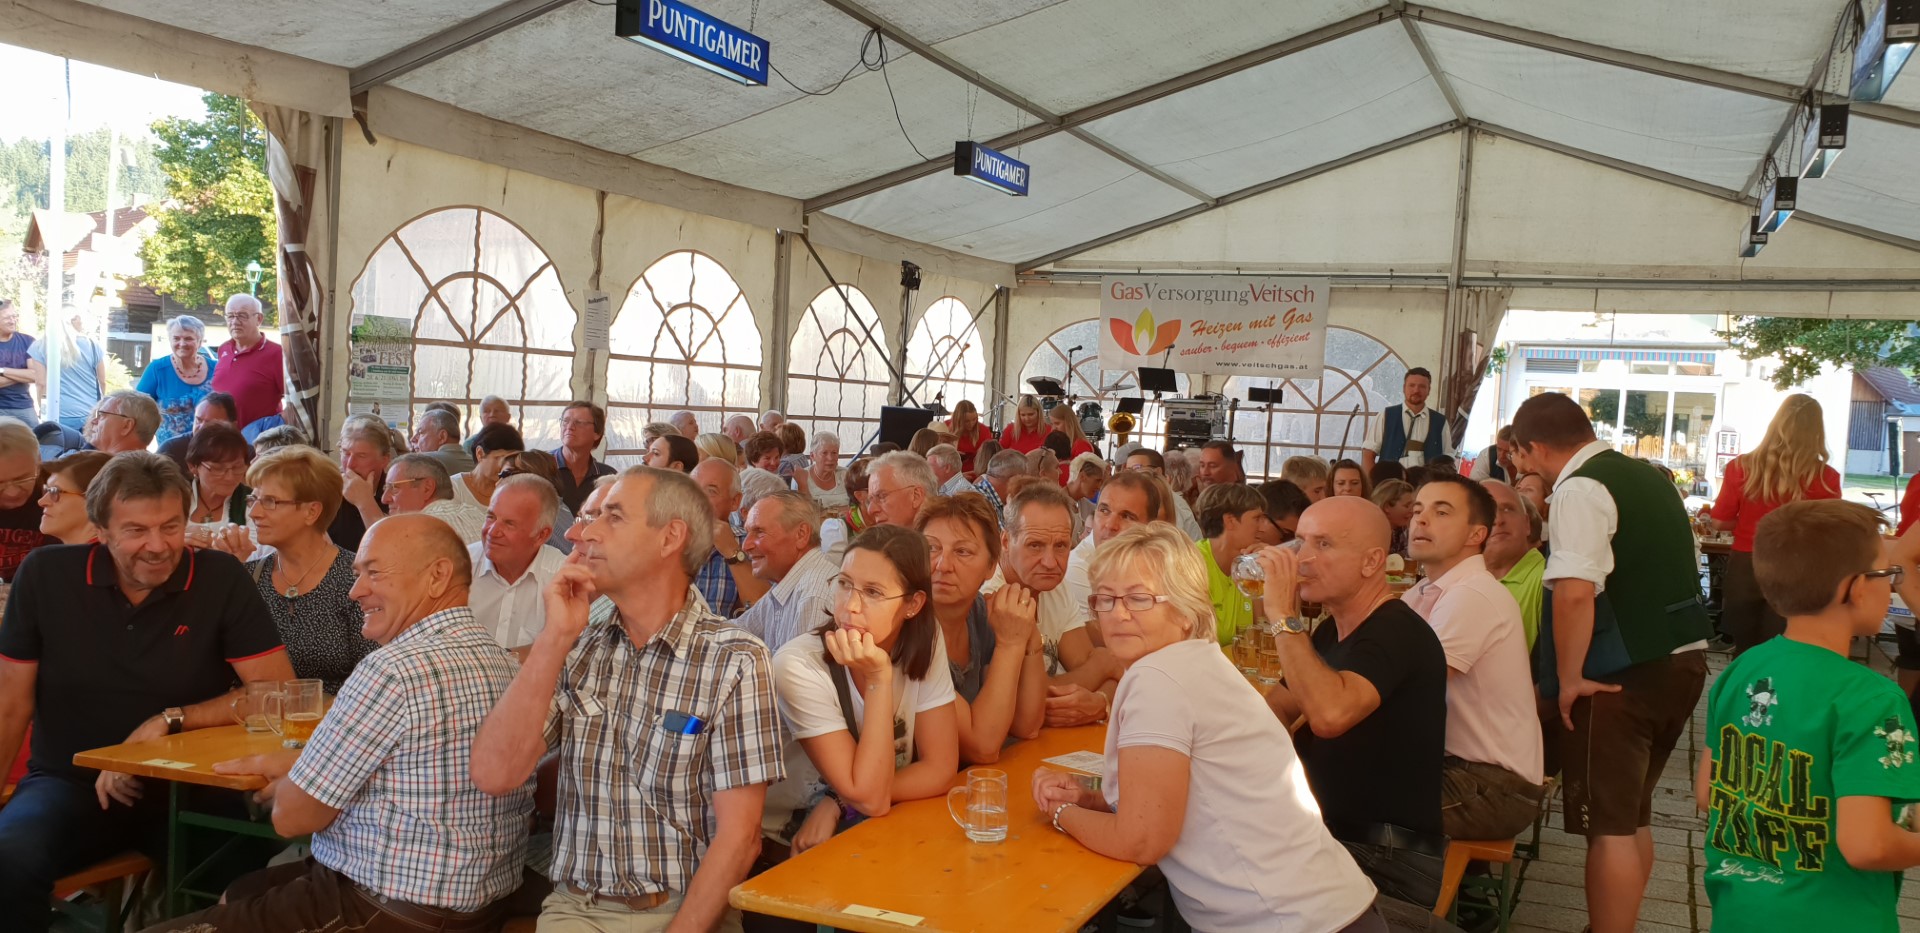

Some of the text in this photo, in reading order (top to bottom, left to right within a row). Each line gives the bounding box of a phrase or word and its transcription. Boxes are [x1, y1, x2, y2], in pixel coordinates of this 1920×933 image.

[648, 0, 761, 71] PUNTIGAMER
[975, 147, 1026, 187] PUNTIGAMER
[1190, 307, 1313, 339] Heizen mit Gas
[1180, 332, 1311, 356] sauber bequem effizient
[1215, 361, 1309, 371] www.veitschgas.at
[1710, 723, 1830, 819] OCAL
[1709, 786, 1829, 872] TAFF
